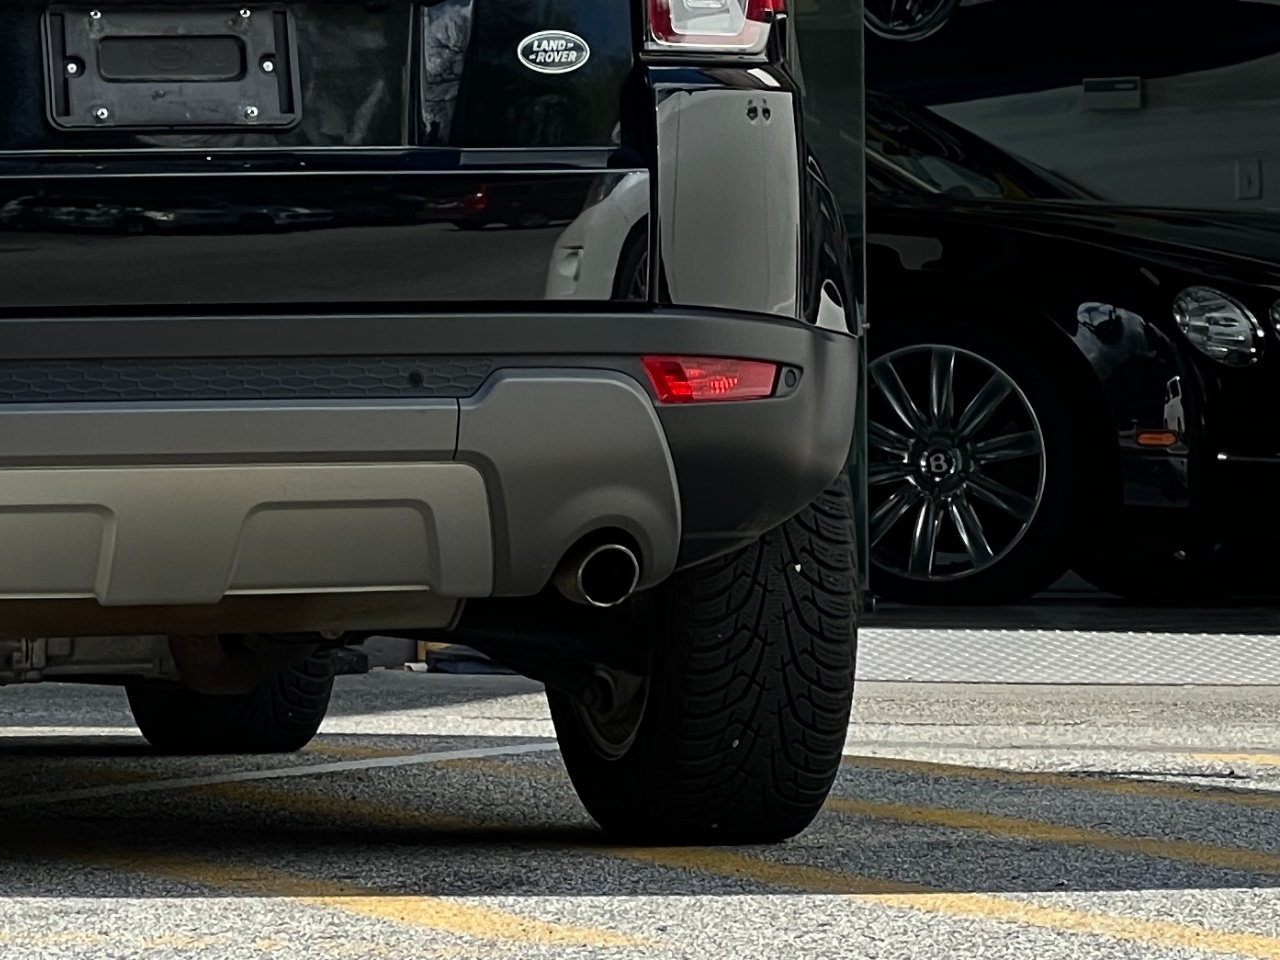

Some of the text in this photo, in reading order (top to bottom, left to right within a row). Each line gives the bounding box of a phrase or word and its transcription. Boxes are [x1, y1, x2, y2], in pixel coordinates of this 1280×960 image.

[533, 39, 567, 52] LAND
[536, 50, 578, 63] ROVER
[929, 453, 949, 473] B
